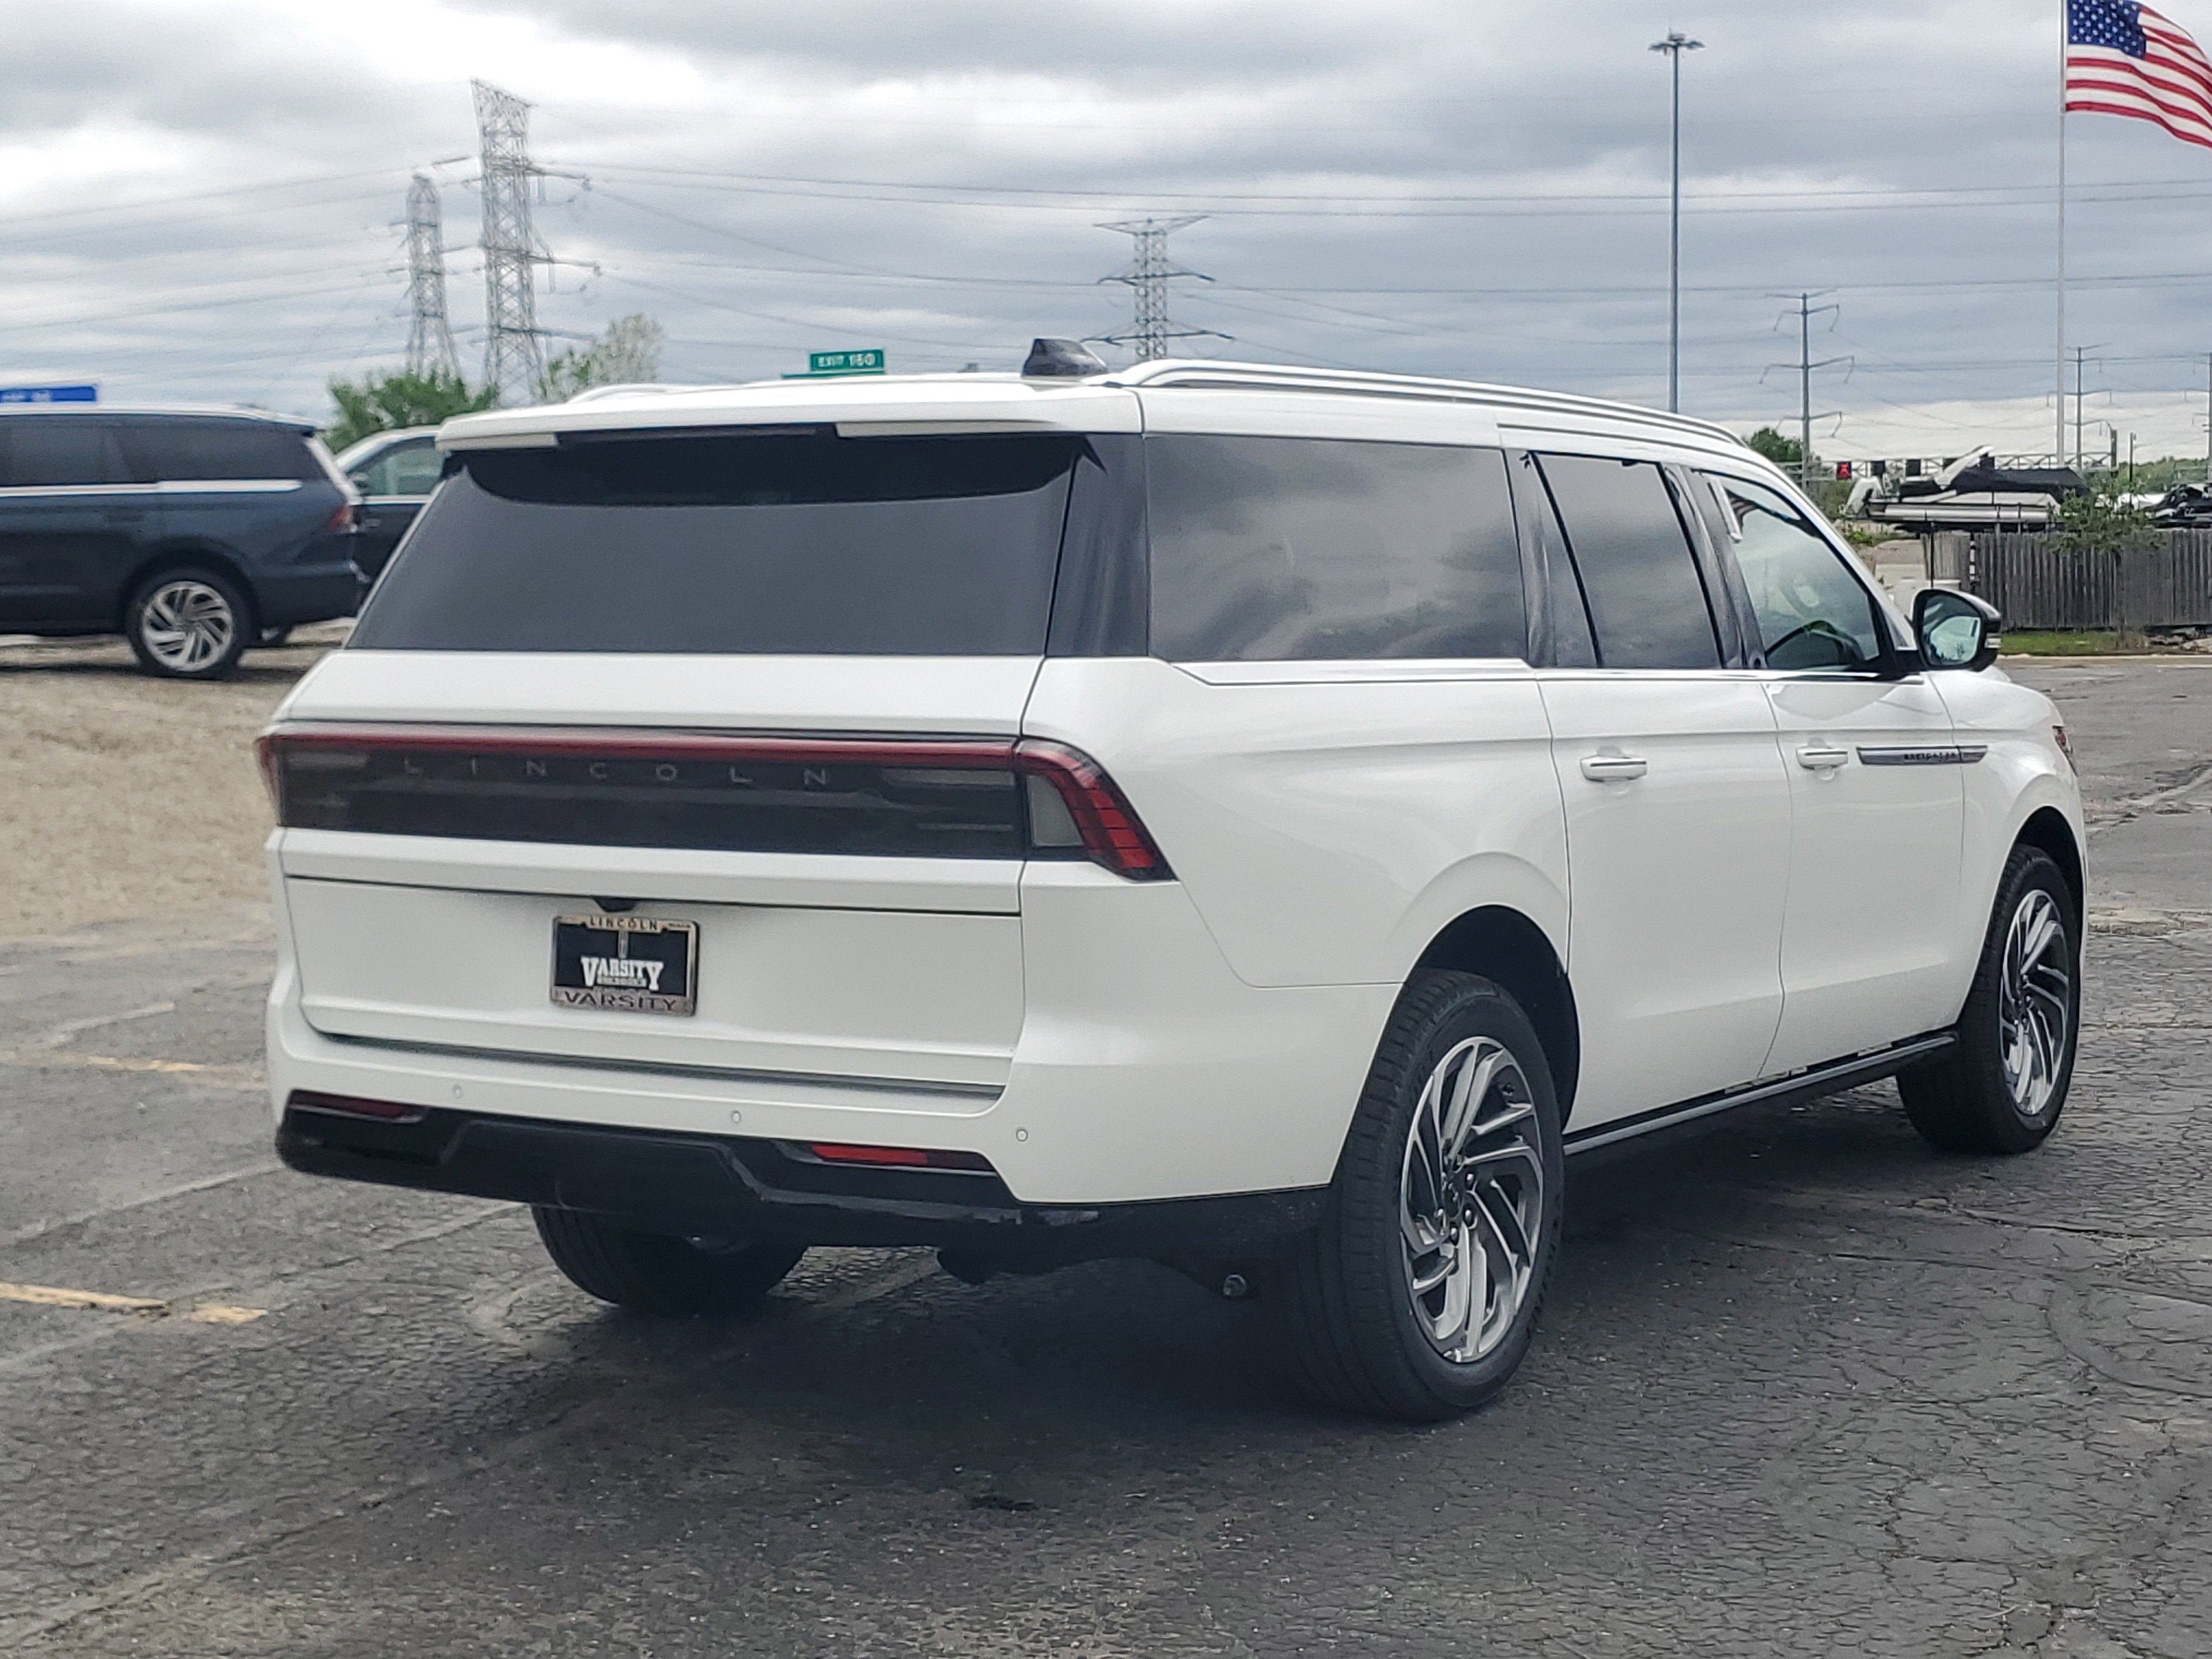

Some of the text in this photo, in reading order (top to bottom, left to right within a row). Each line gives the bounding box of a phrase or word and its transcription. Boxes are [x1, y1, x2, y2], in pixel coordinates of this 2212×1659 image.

[818, 355, 844, 367] EXIT
[404, 758, 828, 786] LINCOLN
[590, 916, 658, 930] LINCOLN
[580, 955, 664, 991] VARSITY
[565, 992, 676, 1011] VARSITY
